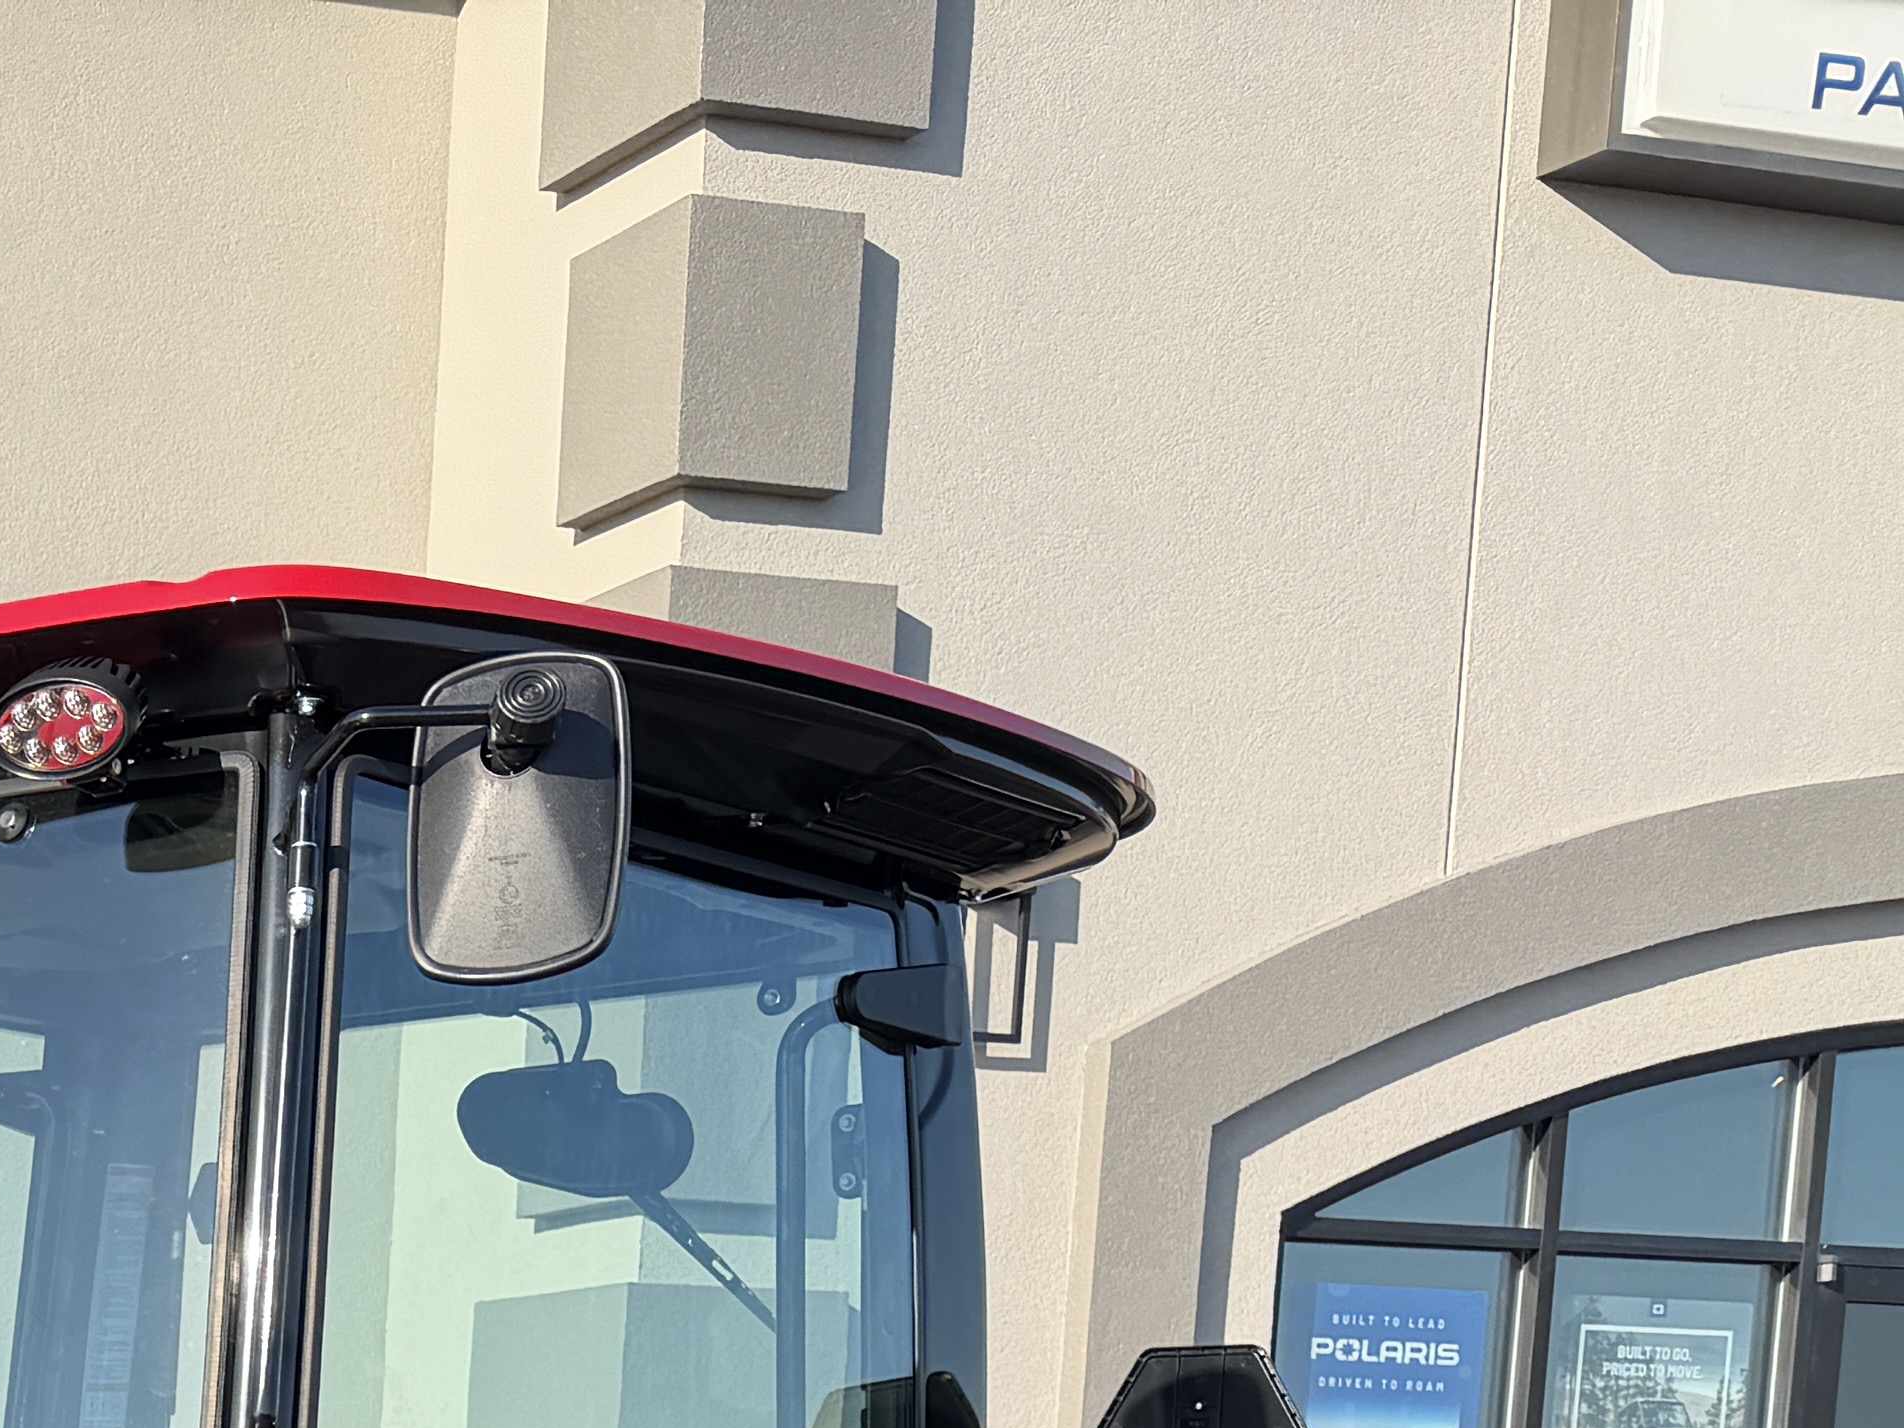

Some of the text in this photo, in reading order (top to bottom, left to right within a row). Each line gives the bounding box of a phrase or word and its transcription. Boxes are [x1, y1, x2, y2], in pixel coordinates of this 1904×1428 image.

[1332, 1314, 1446, 1329] BUILT TO LEAD
[1310, 1337, 1460, 1366] POLARIS
[1617, 1345, 1650, 1359] BUILT
[1656, 1346, 1670, 1360] TO
[1602, 1361, 1646, 1376] PRICED
[1649, 1363, 1665, 1377] TO
[1318, 1376, 1444, 1392] DRIVEN TO ROAM
